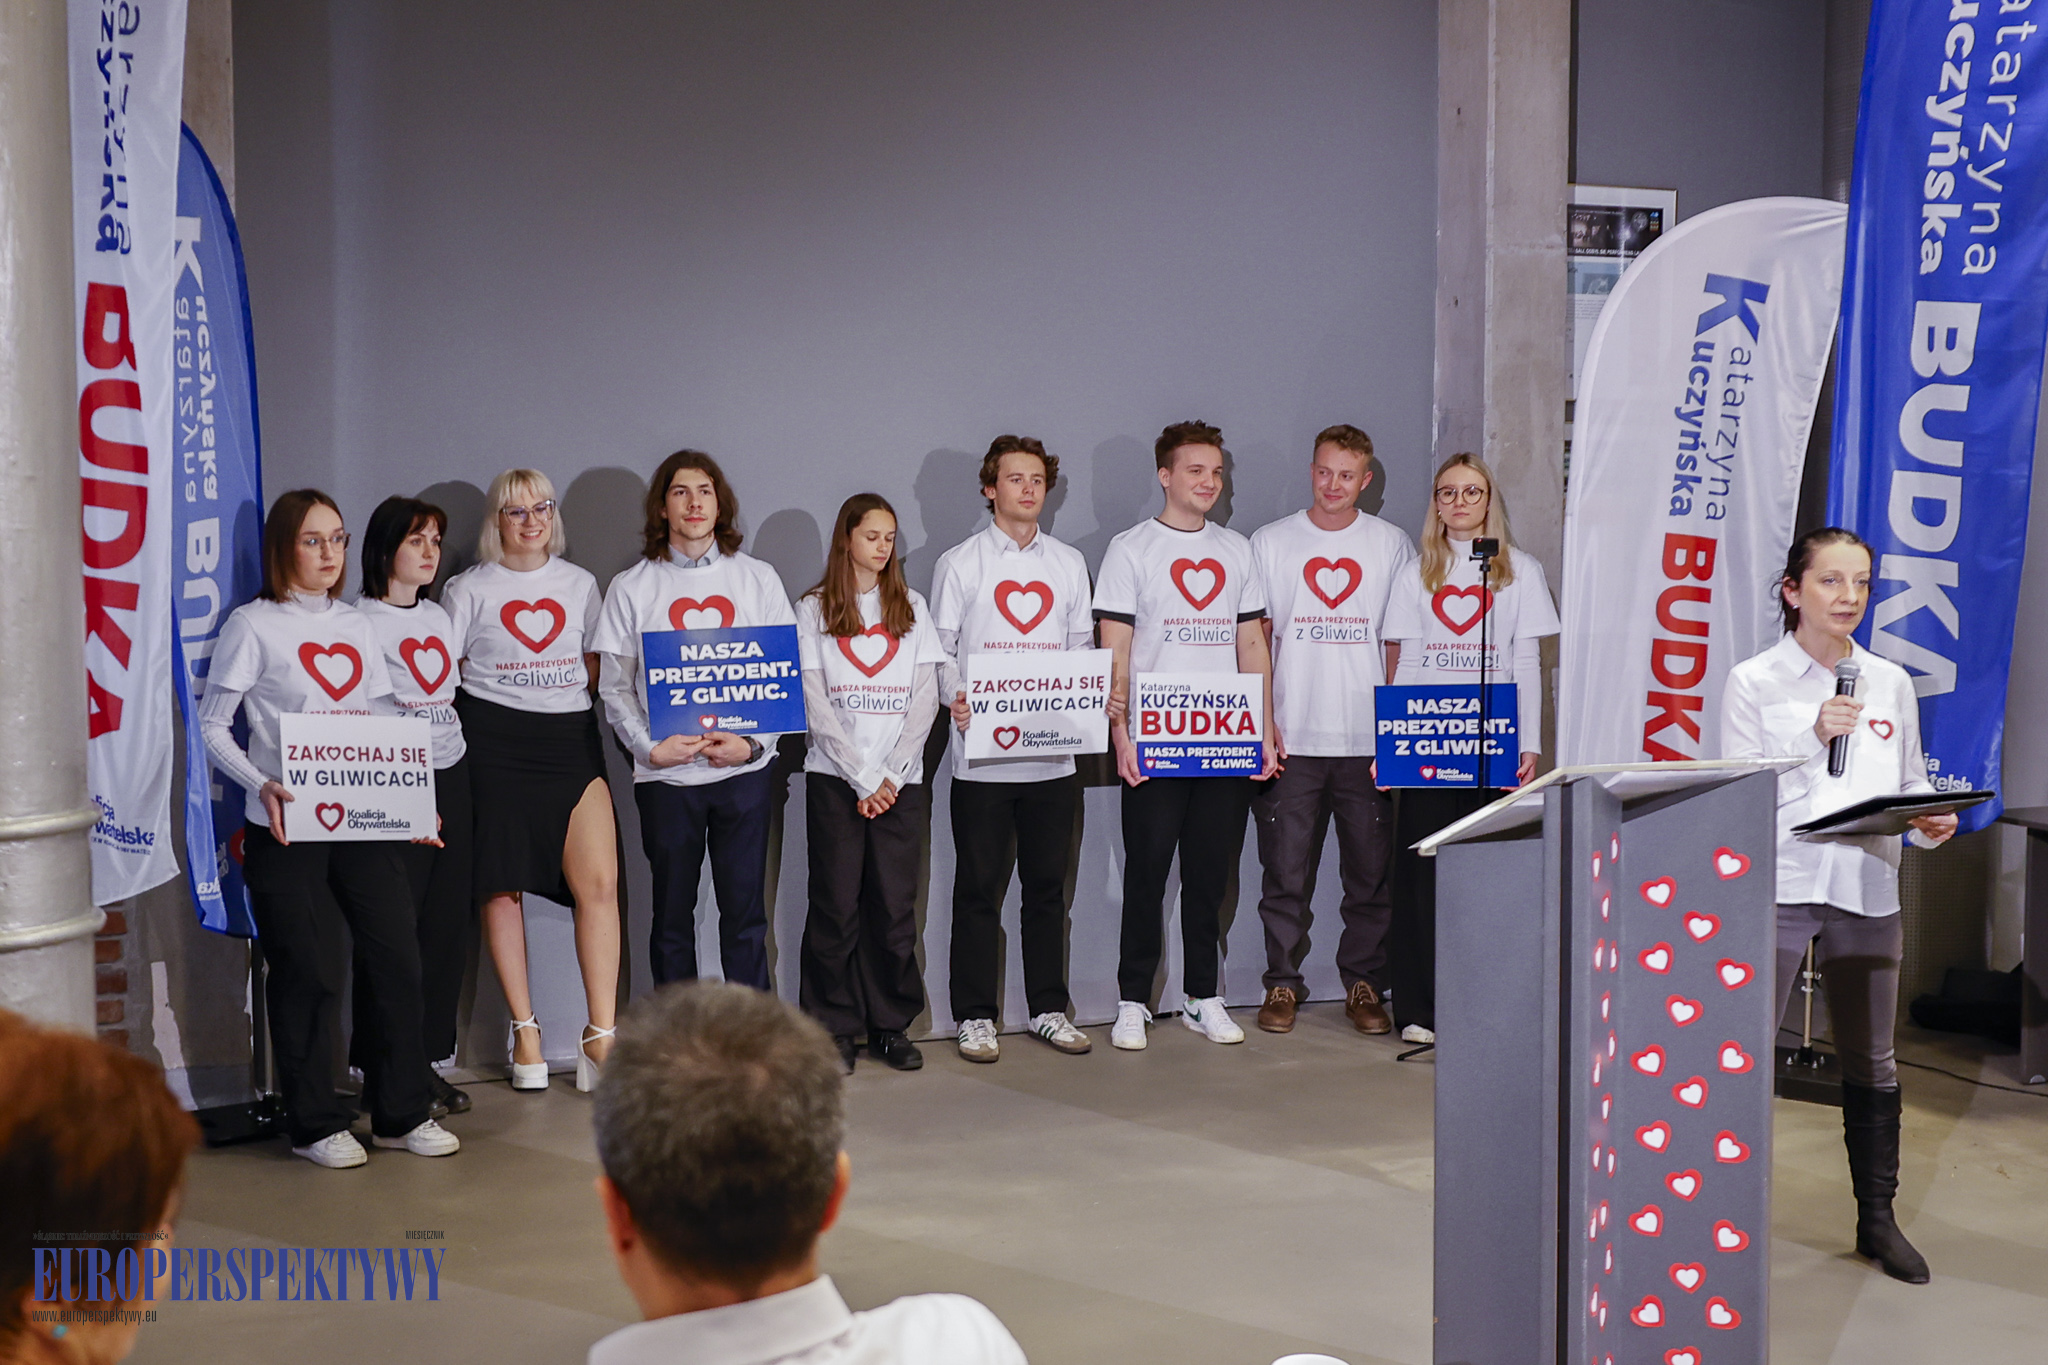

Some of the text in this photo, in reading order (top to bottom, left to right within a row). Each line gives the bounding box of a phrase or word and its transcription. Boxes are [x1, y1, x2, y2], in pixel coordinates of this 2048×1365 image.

[1871, 301, 1981, 700] BUDKA
[1164, 618, 1190, 626] NASZA
[1325, 616, 1370, 625] PREZYDENT
[1164, 630, 1172, 642] z
[1296, 625, 1368, 640] z Gliwic!
[680, 641, 764, 662] NASZA
[984, 641, 1062, 650] NASZA PREZYDENT
[496, 657, 578, 670] NASZA PREZYDENT
[1422, 655, 1430, 667] z
[649, 660, 798, 685] PREZYDENT.
[830, 684, 910, 693] NASZA PREZYDENT
[1079, 675, 1105, 692] SIĘ
[1140, 682, 1191, 694] Katarzyna
[669, 683, 788, 706] Z GLIWIC.
[1140, 690, 1249, 709] KUCZYŃSKA
[972, 696, 1104, 714] W GLIWICACH
[1407, 698, 1481, 715] NASZA
[1141, 711, 1256, 736] BUDKA
[1378, 718, 1516, 736] PREZYDENT.
[1022, 729, 1059, 740] Koalicja
[1022, 736, 1082, 749] Obywatelska
[1395, 739, 1504, 756] Z GLIWIC.
[401, 748, 427, 767] SIĘ
[1144, 746, 1257, 757] NASZA PREZYDENT.
[1201, 758, 1257, 769] Z GLIWIC.
[289, 769, 428, 787] W GLIWICACH
[347, 809, 386, 821] Koalicja
[347, 818, 411, 831] Obywatelska
